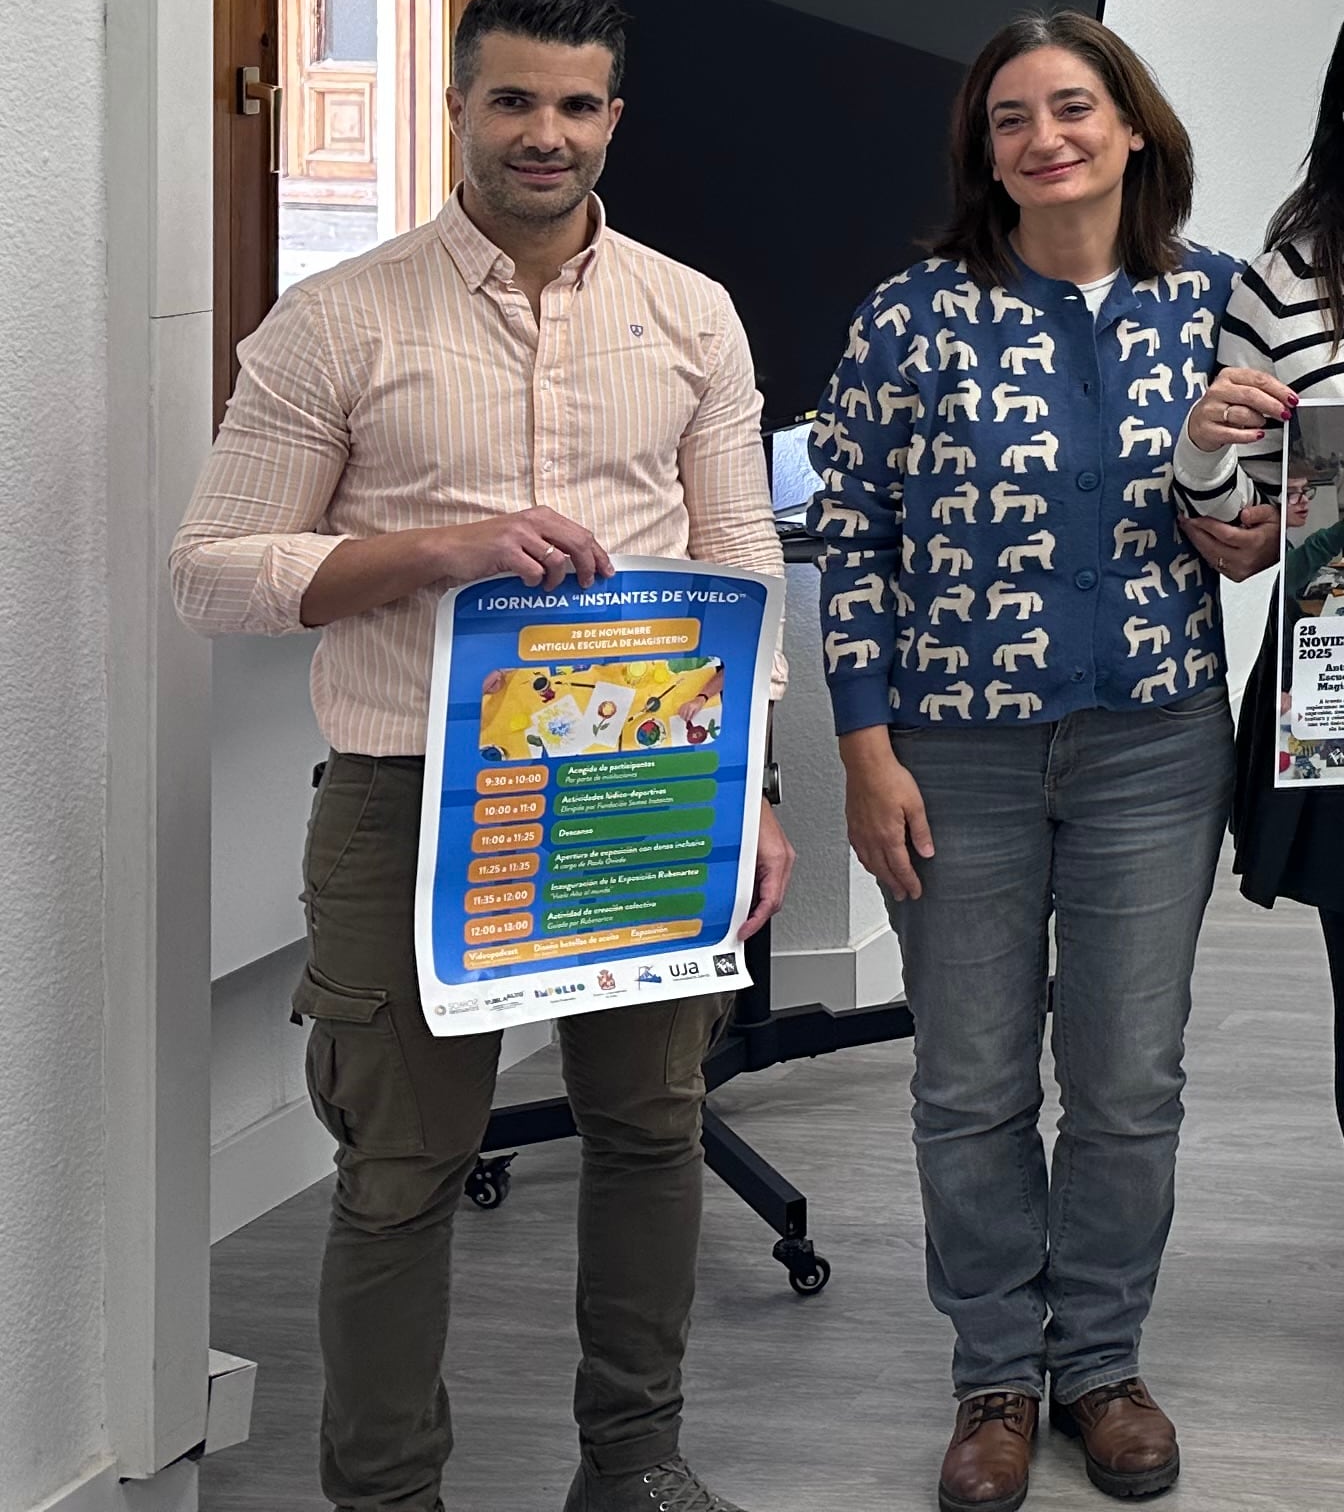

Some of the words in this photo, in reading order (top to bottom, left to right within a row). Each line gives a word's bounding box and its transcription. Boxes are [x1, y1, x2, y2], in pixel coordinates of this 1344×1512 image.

[478, 599, 484, 611] I
[486, 596, 569, 610] JORNADA
[661, 591, 683, 603] DE
[686, 591, 747, 604] VUELO”
[584, 628, 596, 638] DE
[599, 625, 652, 637] NOVIEMBRE
[1300, 626, 1317, 635] 28
[530, 640, 574, 652] ANTIGUA
[577, 638, 617, 650] ESCUELA
[618, 638, 632, 648] DE
[632, 634, 689, 647] MAGISTERIO
[1299, 648, 1332, 660] 2025
[471, 925, 495, 936] 12:00
[504, 921, 528, 931] 13:00
